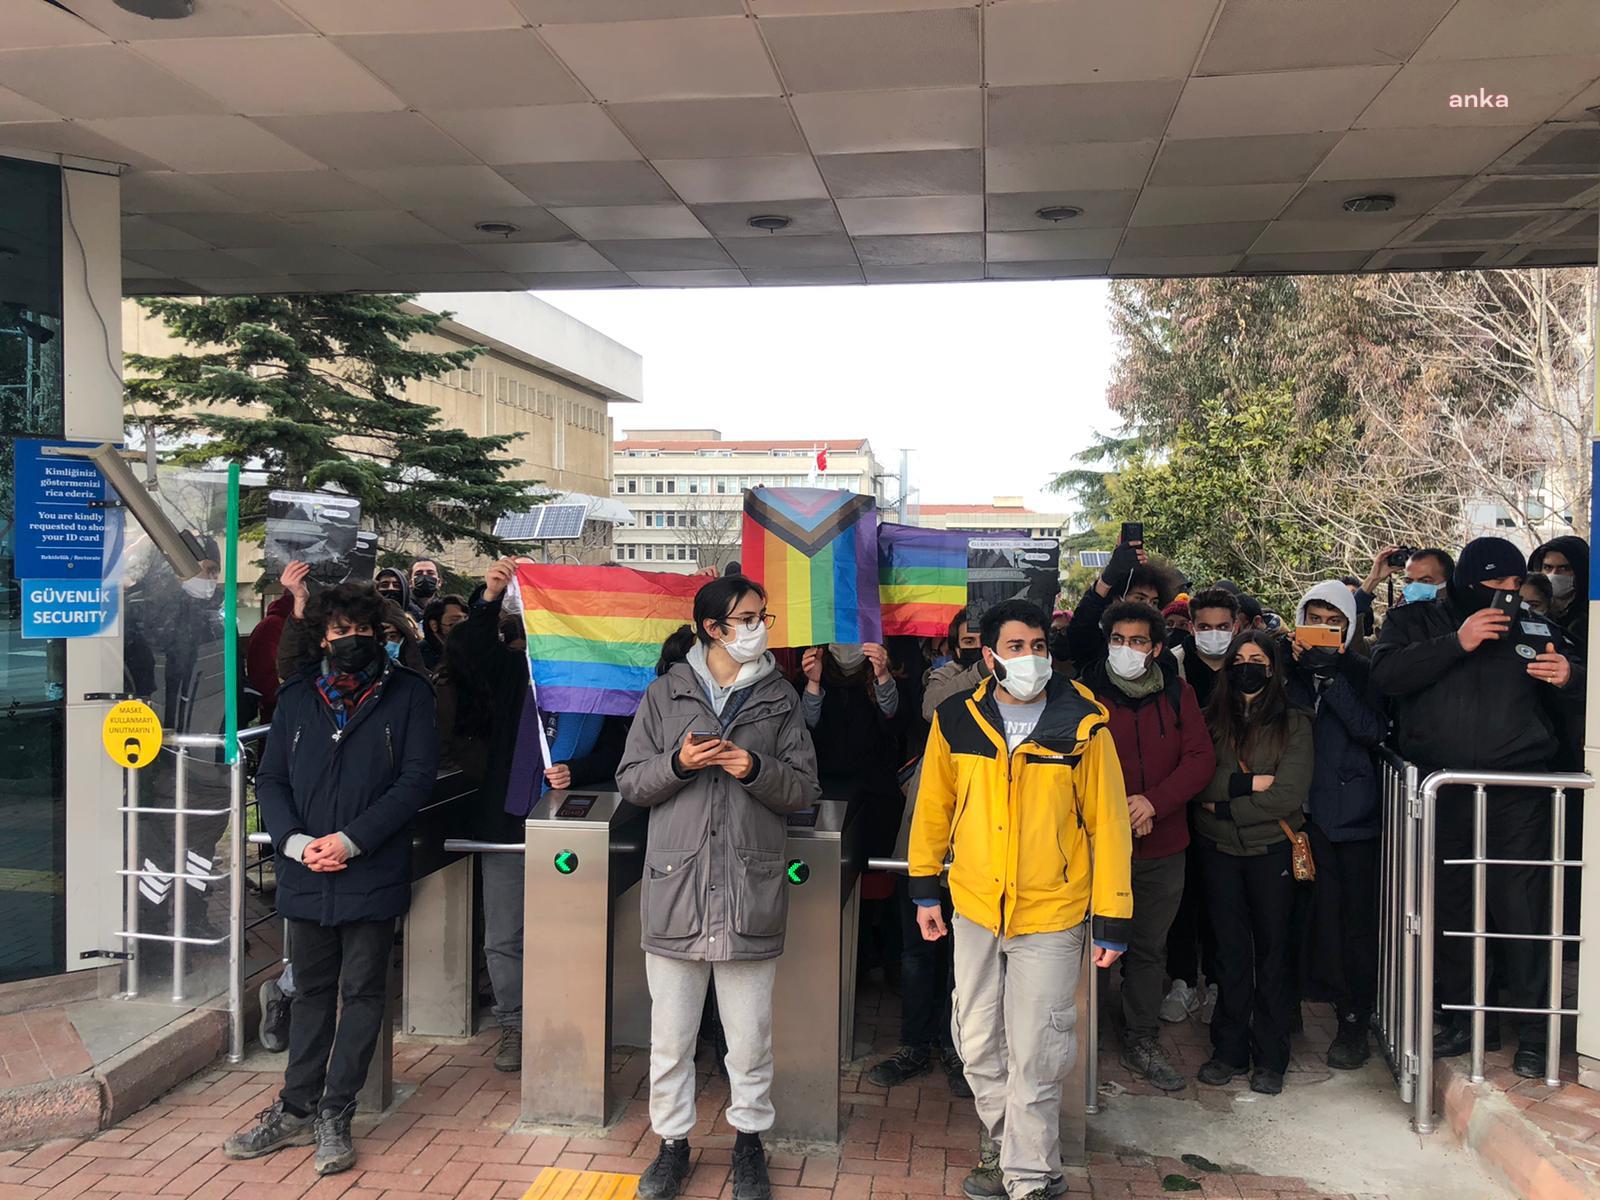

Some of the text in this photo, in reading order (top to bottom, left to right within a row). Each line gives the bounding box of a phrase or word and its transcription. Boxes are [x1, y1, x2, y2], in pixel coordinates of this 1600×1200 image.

[45, 467, 97, 478] Kimliğinizi
[40, 478, 101, 488] göstermenizi
[45, 489, 96, 498] rica ederiz.
[38, 511, 57, 520] You
[74, 512, 104, 523] kindly
[29, 523, 76, 532] requested
[88, 523, 106, 532] sho
[41, 533, 99, 542] your ID card
[30, 588, 110, 603] GÜVENLİK
[33, 610, 107, 624] SECURITY
